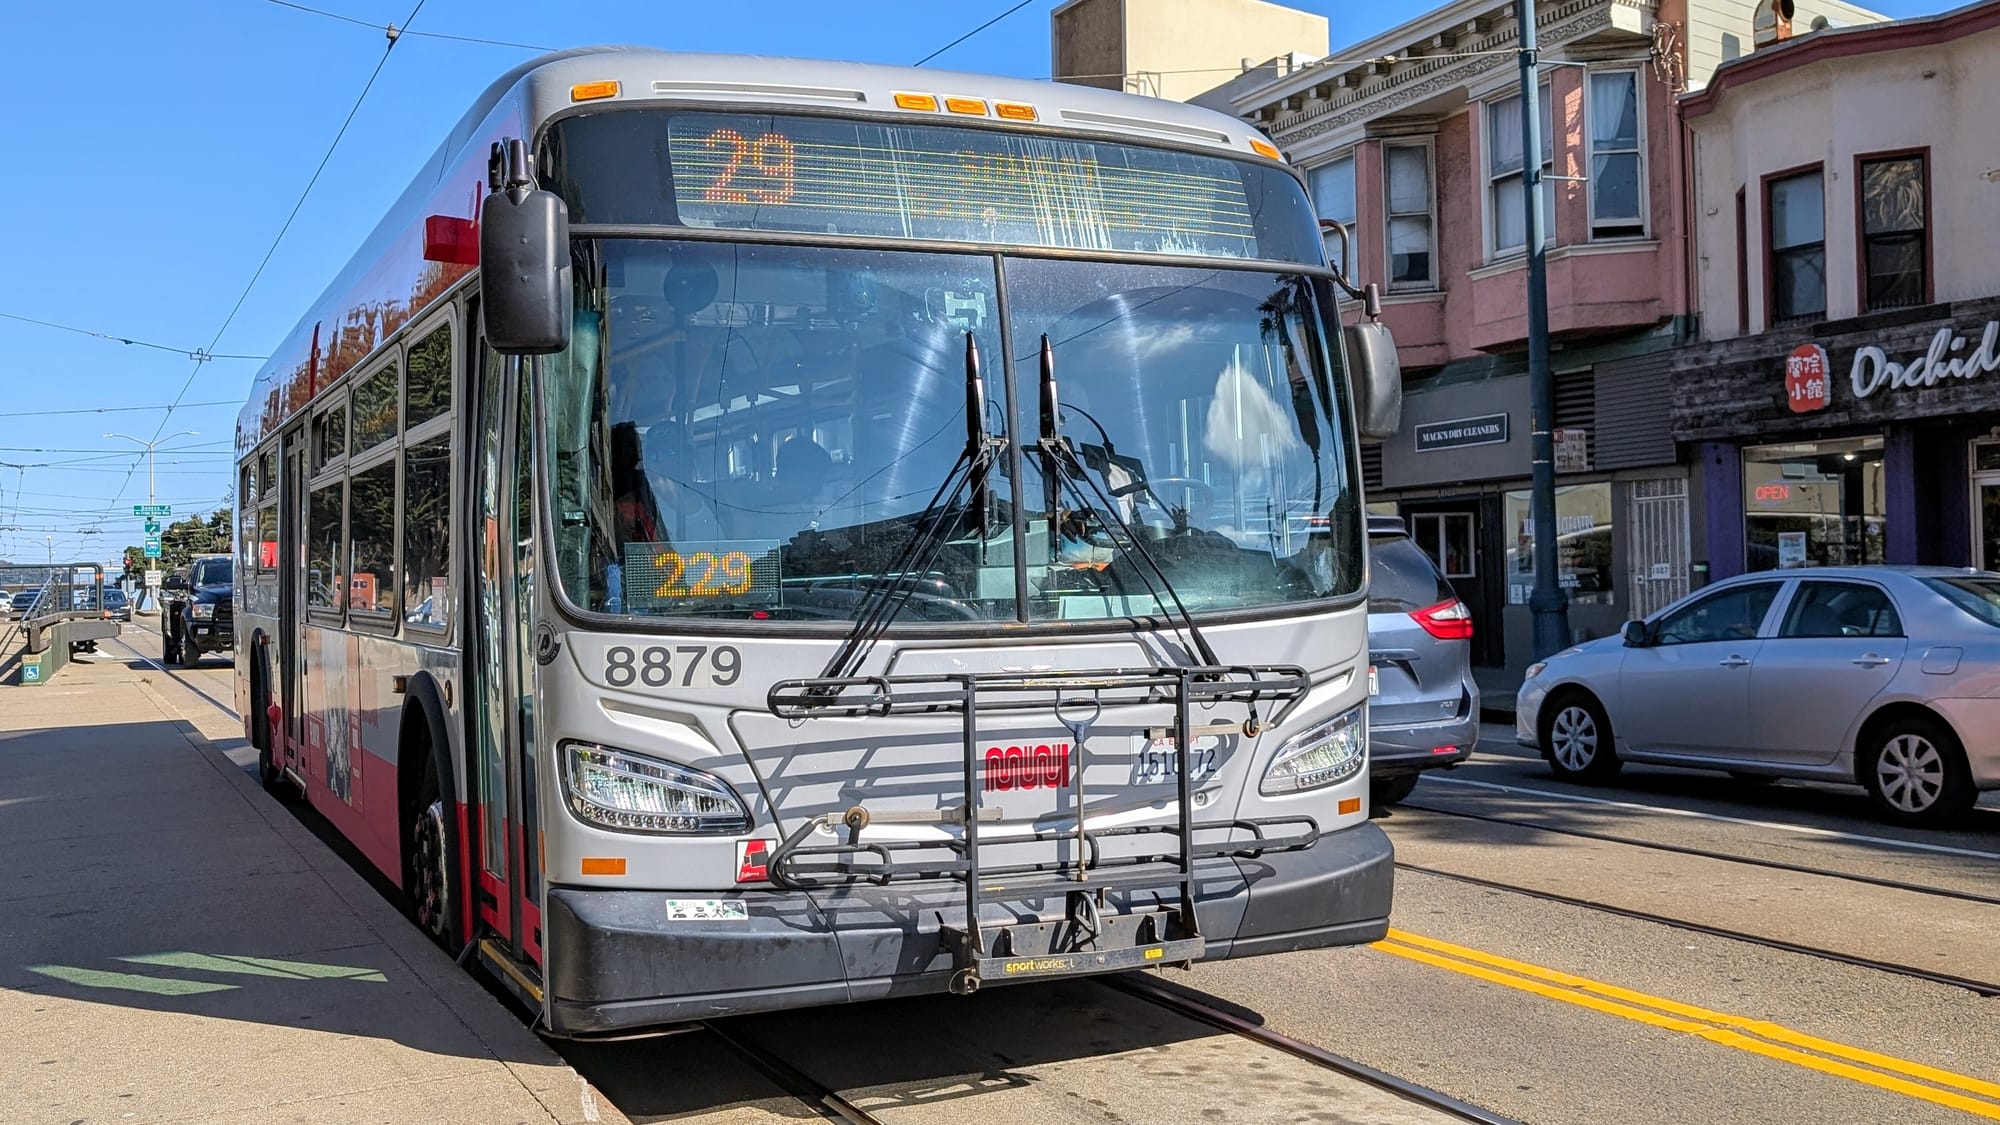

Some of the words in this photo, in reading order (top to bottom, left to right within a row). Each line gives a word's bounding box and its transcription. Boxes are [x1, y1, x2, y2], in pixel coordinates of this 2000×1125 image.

[705, 129, 794, 204] 29
[1850, 320, 2000, 399] Orchid
[1422, 430, 1449, 442] MACK'S
[1448, 429, 1462, 440] DRY
[1463, 424, 1500, 437] CLEANERS
[1755, 485, 1788, 500] OPEN
[655, 551, 752, 598] 229
[605, 645, 742, 687] 8879
[1168, 735, 1201, 747] EPT
[1137, 748, 1217, 778] 151072
